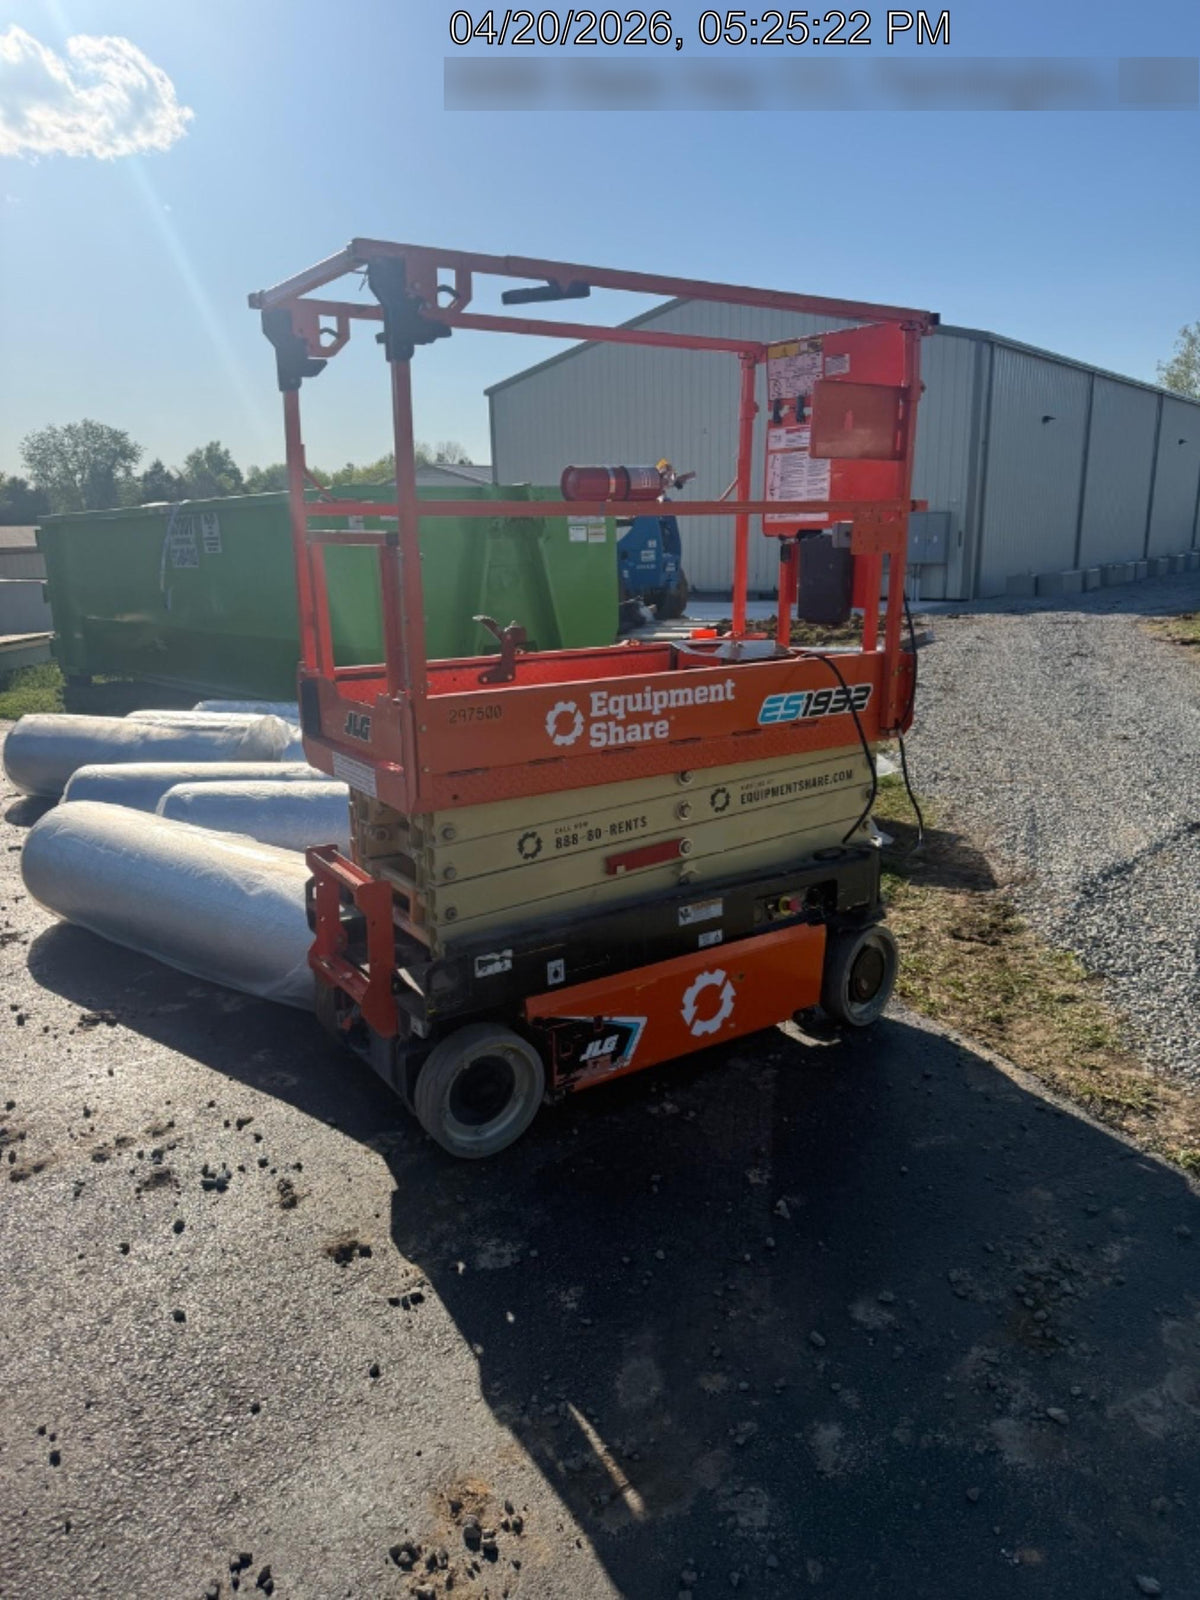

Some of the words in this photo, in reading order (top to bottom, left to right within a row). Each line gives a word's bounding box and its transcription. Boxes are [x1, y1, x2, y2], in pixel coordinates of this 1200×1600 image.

[449, 704, 502, 724] 297500
[589, 678, 736, 721] Equipment
[757, 683, 874, 725] ES1932
[344, 710, 373, 743] JLG
[589, 719, 670, 748] Share
[740, 769, 853, 805] EQUIPMENTSHARE.COM
[579, 1034, 619, 1062] JLG
